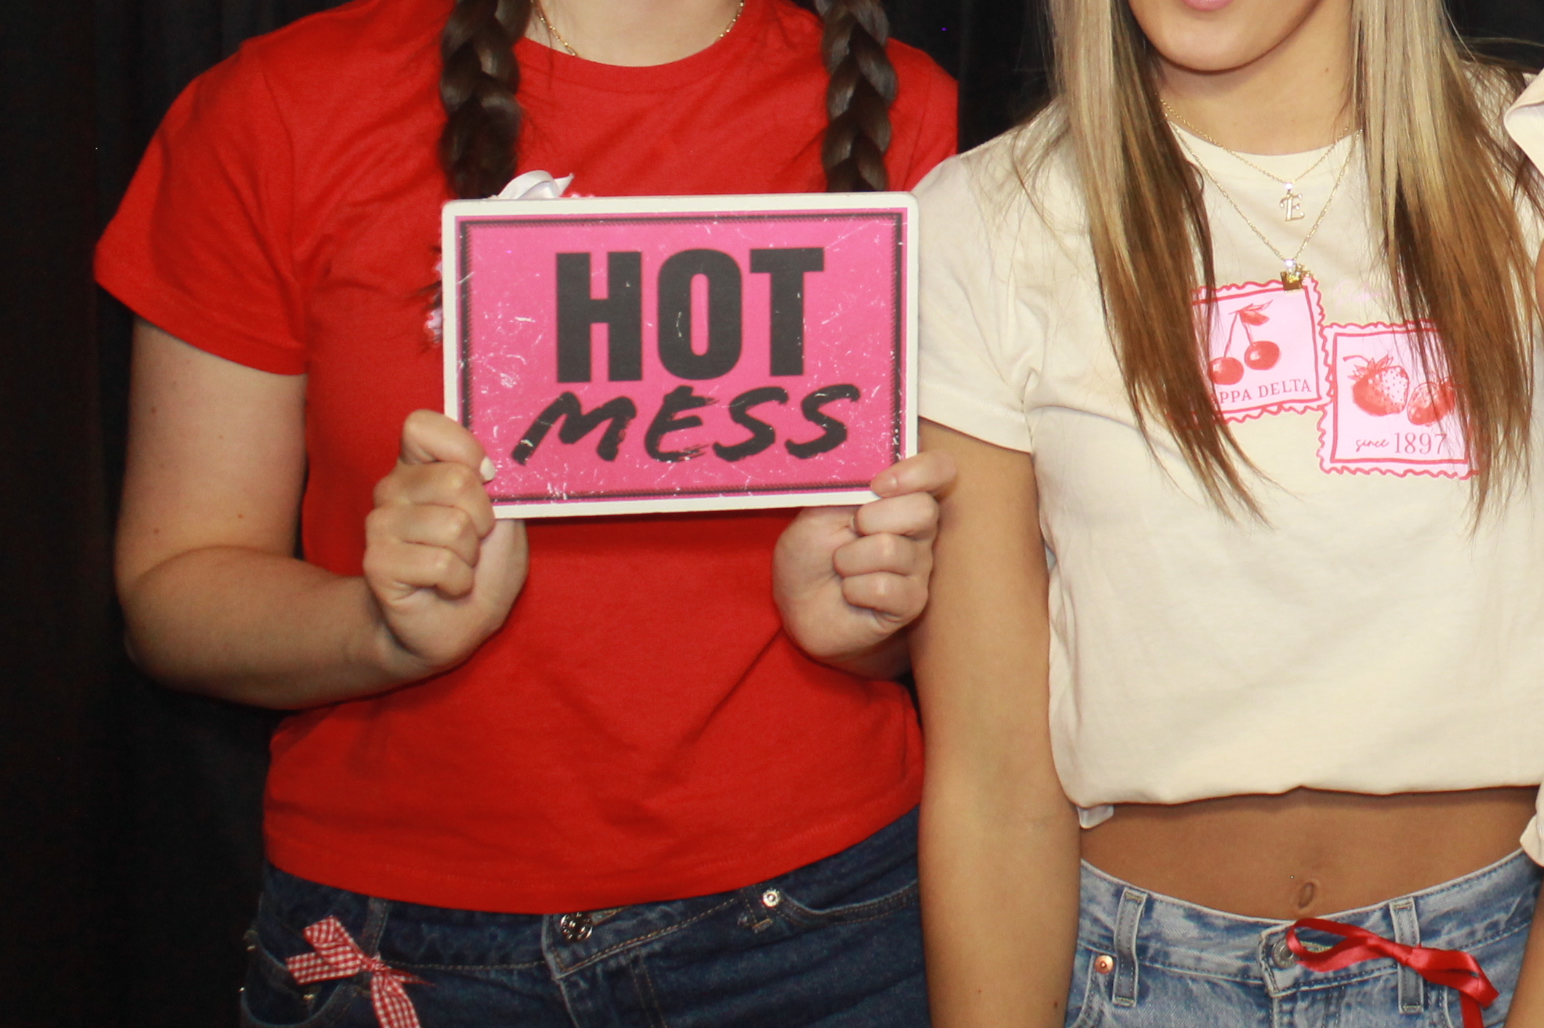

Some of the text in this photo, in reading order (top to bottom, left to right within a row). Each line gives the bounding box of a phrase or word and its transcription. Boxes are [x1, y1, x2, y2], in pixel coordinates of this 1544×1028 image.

[555, 247, 825, 384] HOT
[1216, 378, 1313, 406] PPA DELTA
[511, 384, 861, 466] MESS
[1355, 432, 1448, 455] since 1897
